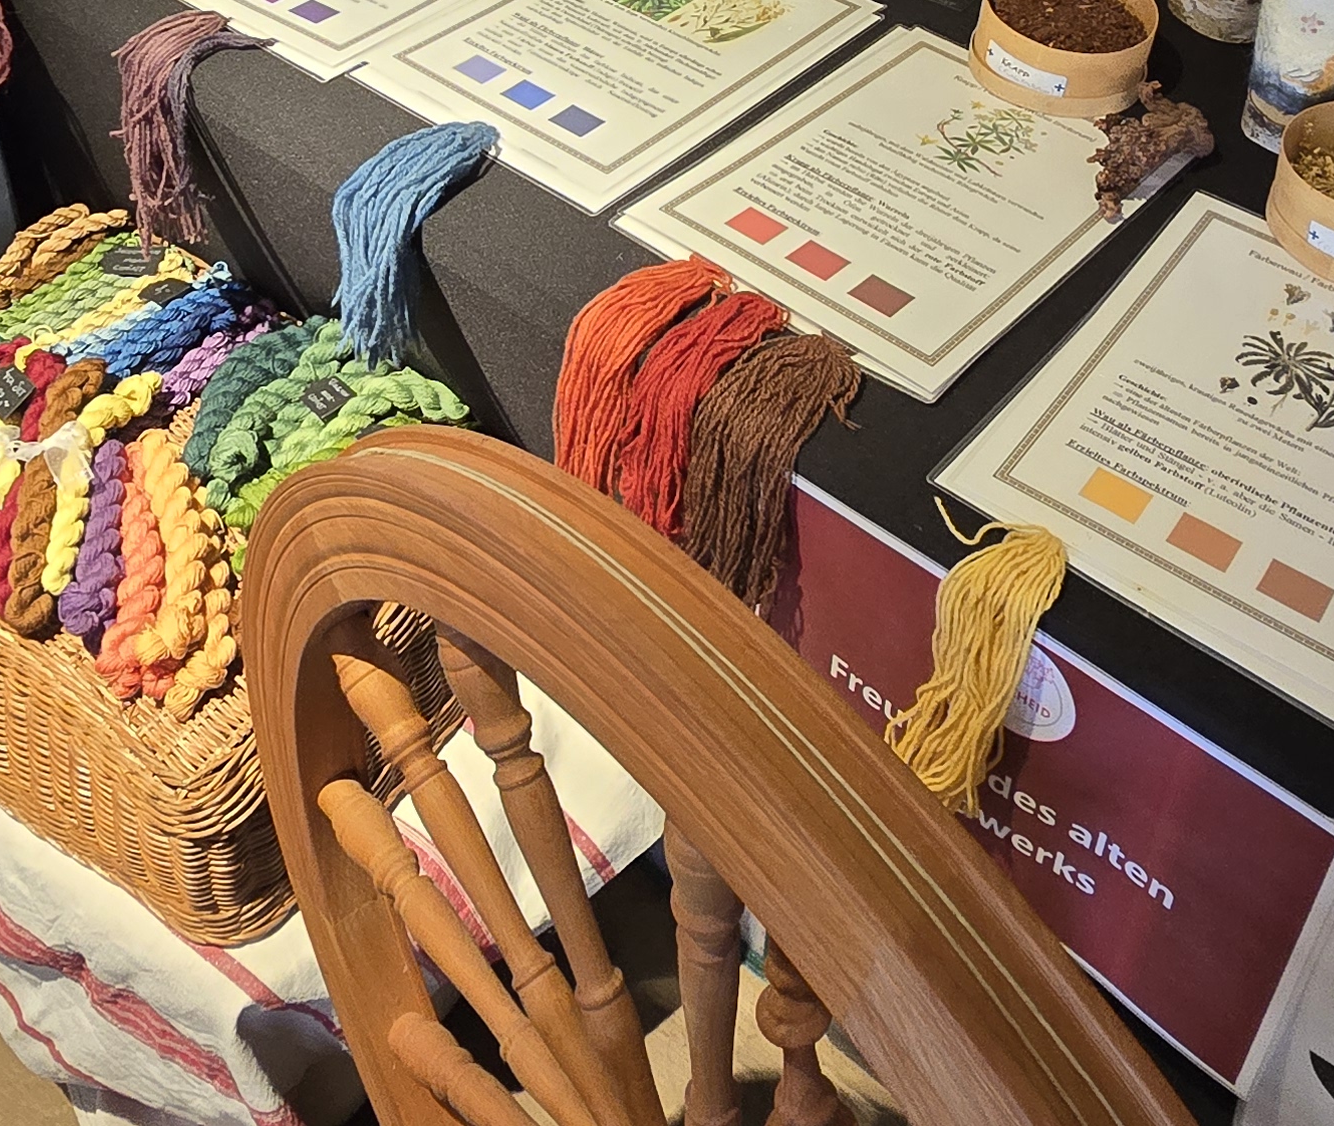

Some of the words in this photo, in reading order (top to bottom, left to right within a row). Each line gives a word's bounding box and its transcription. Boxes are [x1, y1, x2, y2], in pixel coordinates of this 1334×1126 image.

[1065, 437, 1113, 467] Erzieltes
[1111, 461, 1193, 508] Farbspektrum:
[1099, 422, 1135, 444] Blätter
[1155, 451, 1196, 476] Stängel
[1277, 511, 1316, 536] Samen
[1116, 441, 1153, 465] gelben
[1152, 460, 1206, 491] Farbstoff
[1201, 485, 1258, 519] (Luteolin)
[1209, 466, 1279, 506] oberirdische
[978, 810, 1095, 895] werks
[988, 775, 1057, 827] des
[1069, 823, 1175, 909] alten
